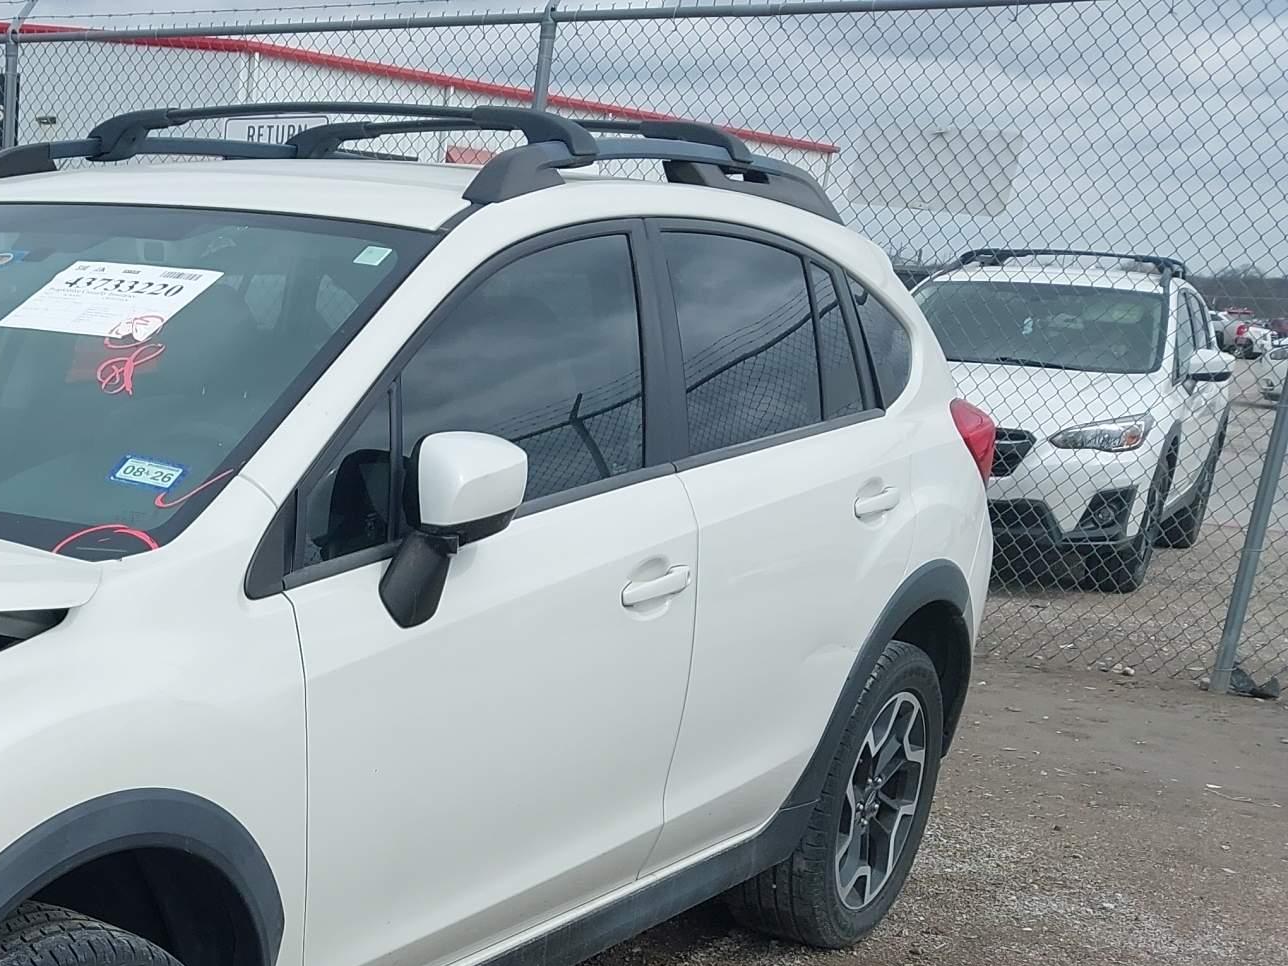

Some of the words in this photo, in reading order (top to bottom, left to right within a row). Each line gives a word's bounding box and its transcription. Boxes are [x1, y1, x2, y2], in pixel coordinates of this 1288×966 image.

[65, 276, 184, 298] 43733220
[122, 465, 146, 477] 08
[150, 470, 174, 483] 26
